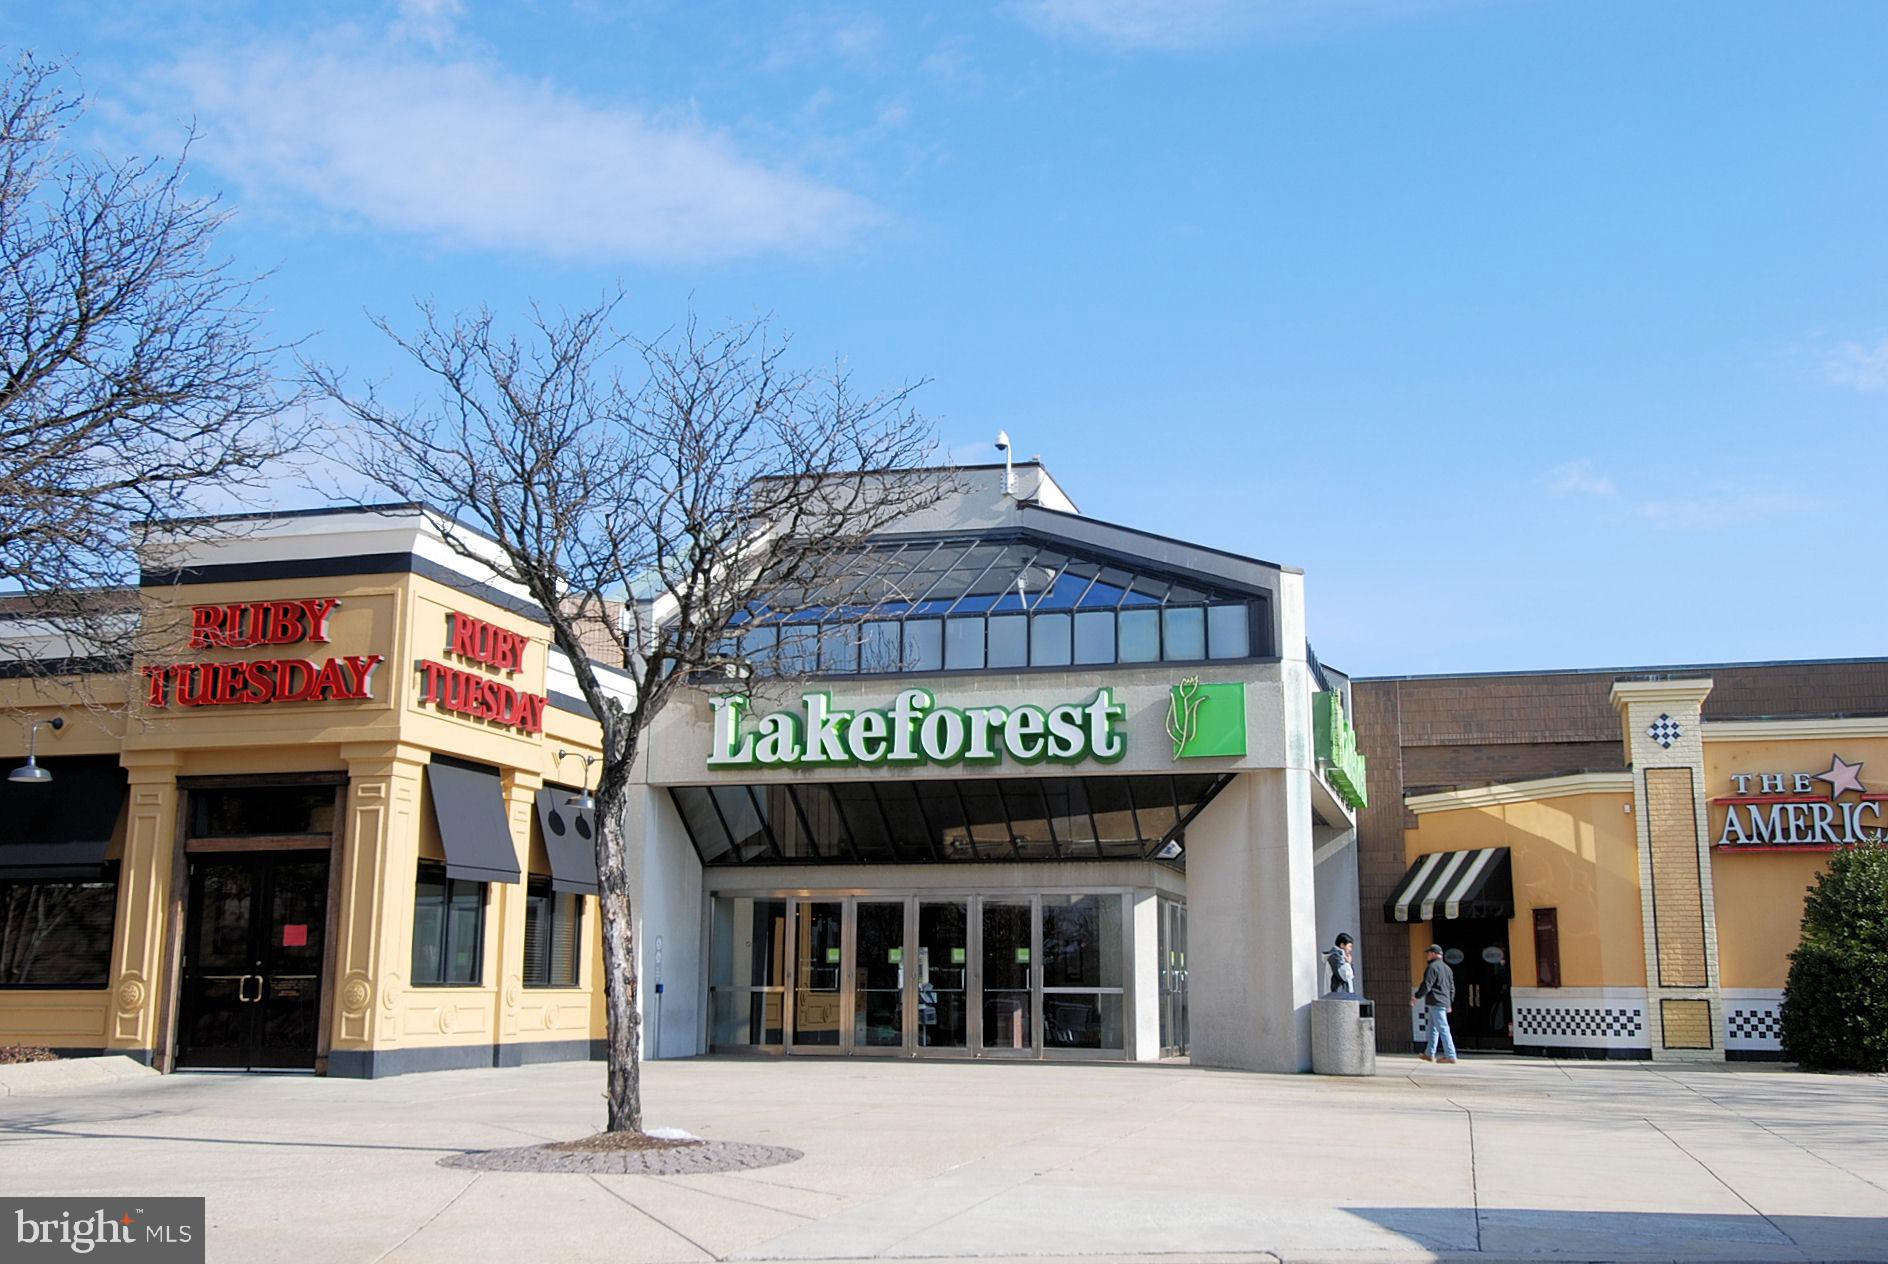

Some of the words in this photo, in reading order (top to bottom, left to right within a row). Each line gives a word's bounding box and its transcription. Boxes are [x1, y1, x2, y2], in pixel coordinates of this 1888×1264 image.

[188, 599, 340, 649] RUBY
[445, 611, 530, 674] RUBY
[141, 655, 384, 708] TUESDAY
[415, 659, 549, 733] TUESDAY
[707, 687, 1127, 768] Lakeforest
[1730, 773, 1812, 794] THE
[1718, 801, 1888, 845] AMERIC
